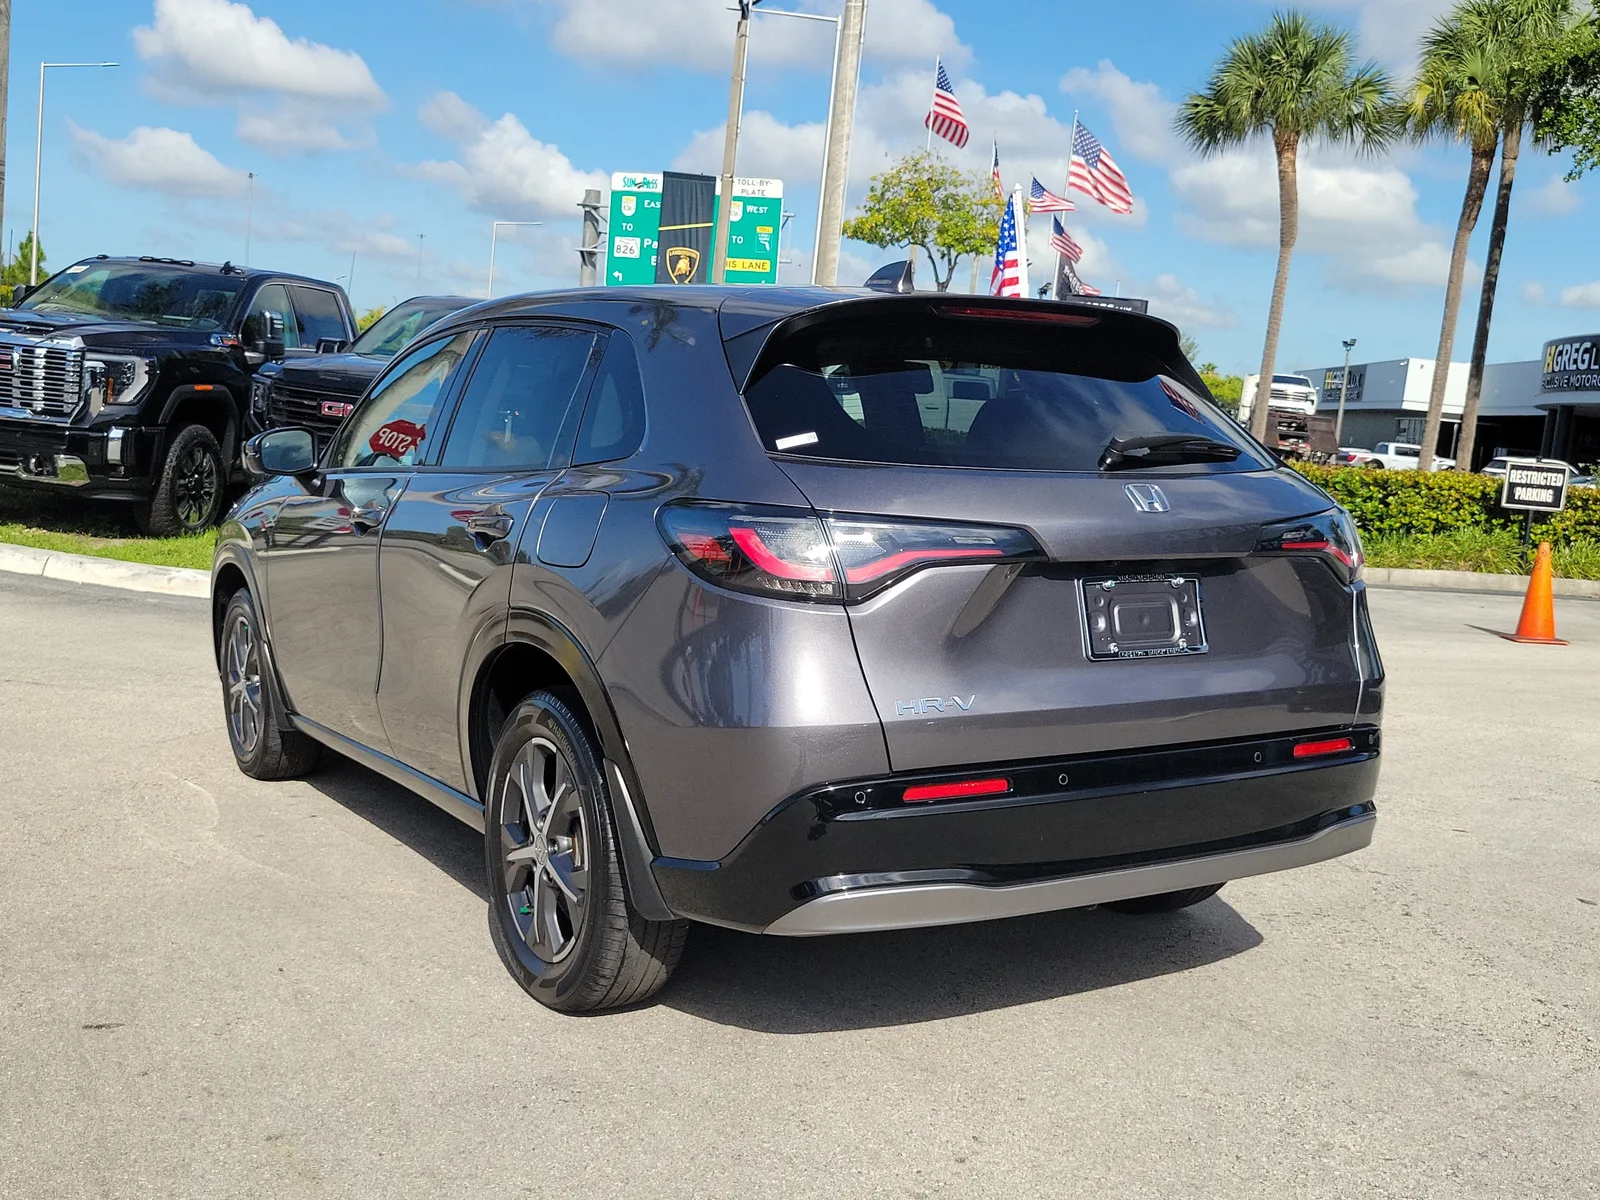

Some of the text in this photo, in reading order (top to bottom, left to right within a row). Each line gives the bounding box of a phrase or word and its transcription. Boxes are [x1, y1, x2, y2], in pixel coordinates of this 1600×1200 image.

[741, 188, 766, 197] PLATE
[746, 204, 768, 214] WEST
[622, 222, 634, 232] TO
[731, 235, 744, 245] TO
[615, 244, 635, 255] 826
[742, 261, 768, 271] LANE
[1509, 469, 1564, 487] RESTRICTED
[1514, 486, 1555, 503] PARKING
[895, 694, 976, 716] HR-V
